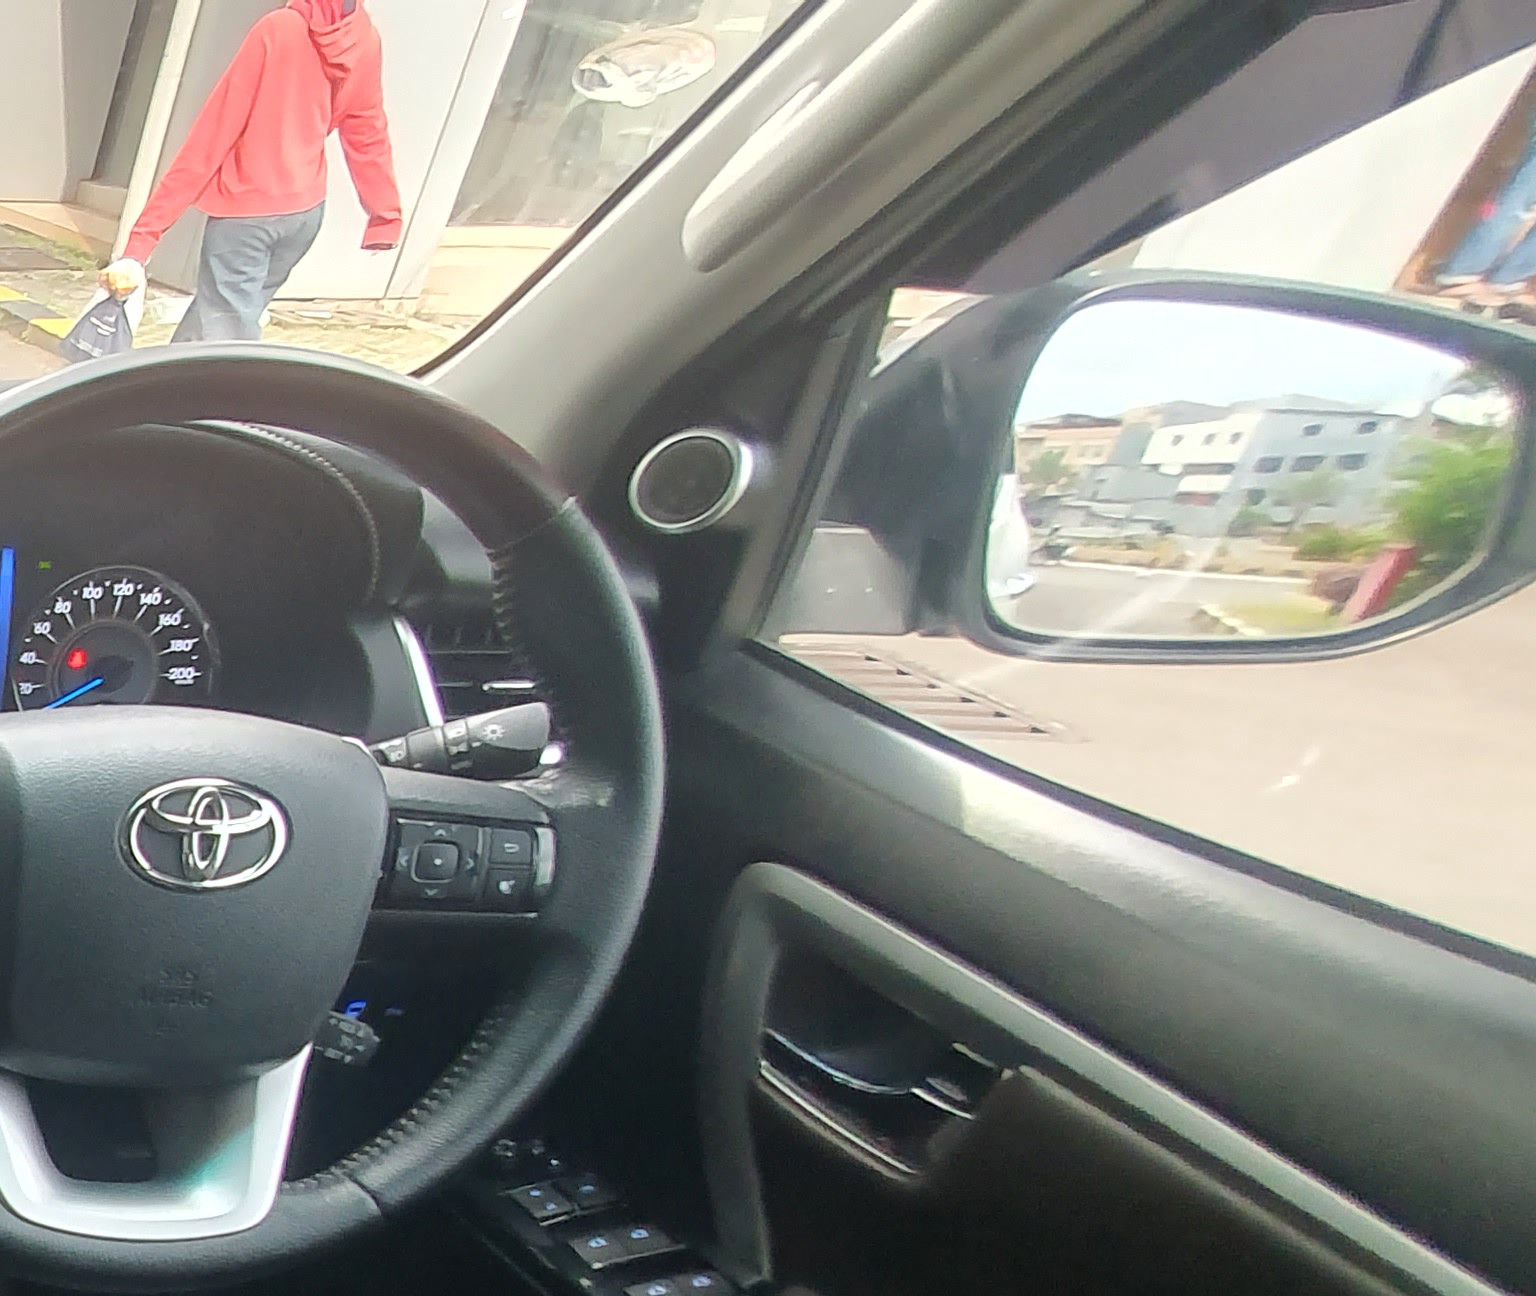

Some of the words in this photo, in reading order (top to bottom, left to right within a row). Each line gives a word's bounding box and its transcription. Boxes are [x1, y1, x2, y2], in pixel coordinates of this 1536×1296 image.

[82, 586, 104, 599] 100
[113, 583, 134, 596] 120
[140, 592, 162, 605] 140
[54, 601, 71, 614] 80
[158, 612, 182, 626] 160
[33, 621, 51, 634] 60
[169, 639, 194, 652] 180
[19, 652, 36, 664] 40
[168, 667, 196, 681] 200
